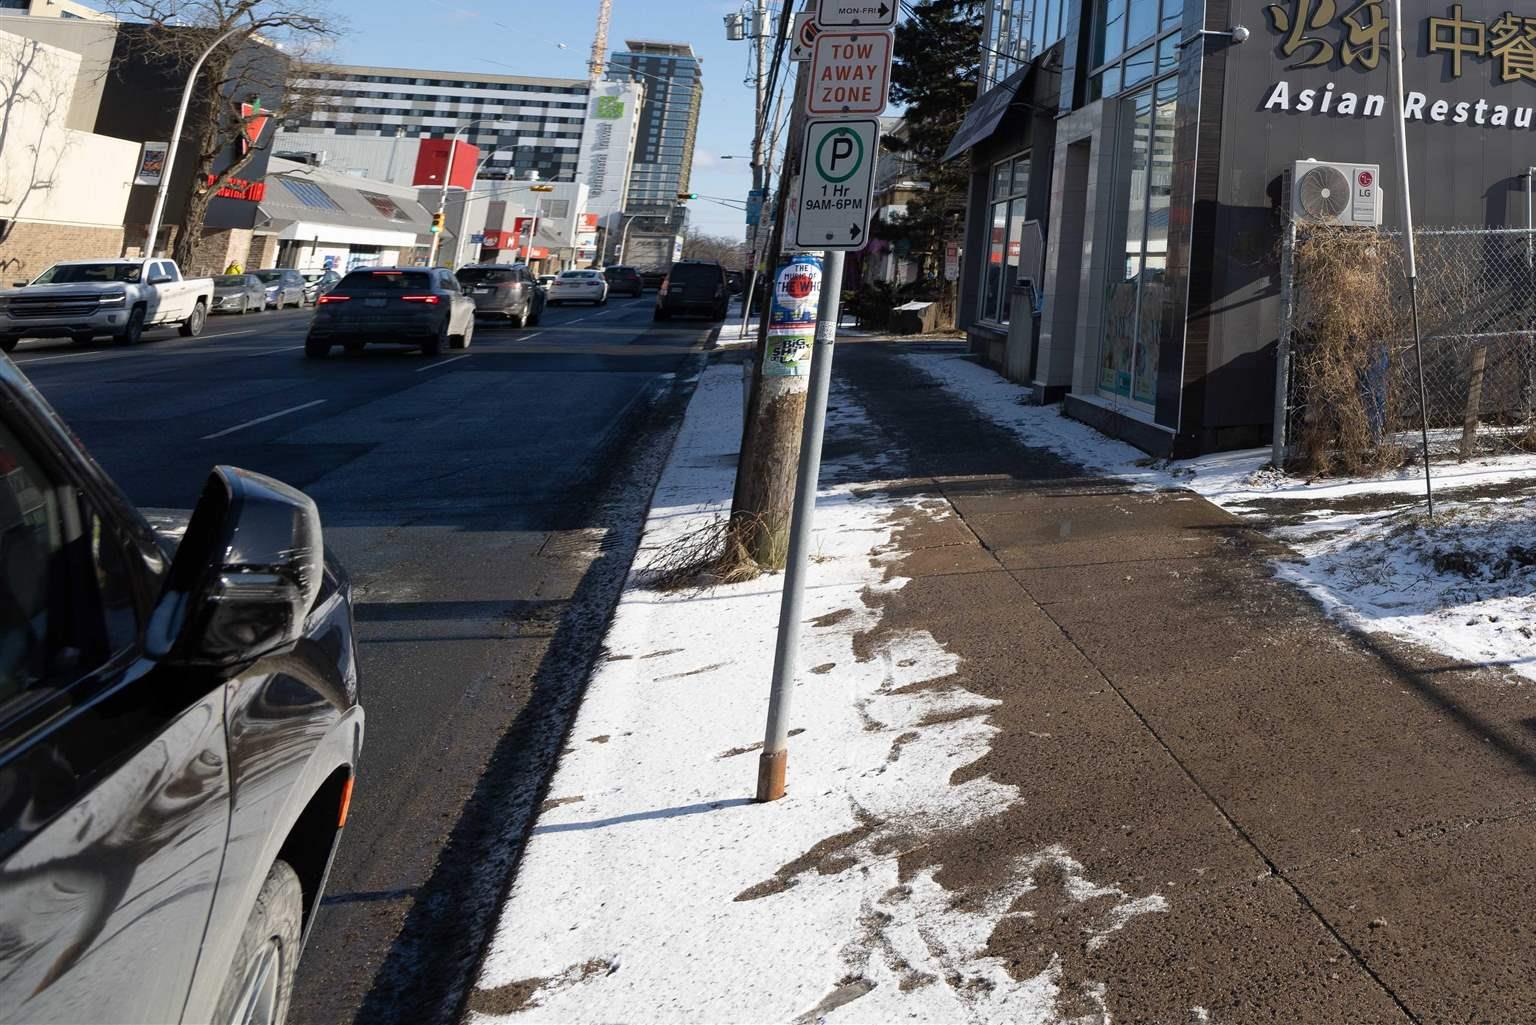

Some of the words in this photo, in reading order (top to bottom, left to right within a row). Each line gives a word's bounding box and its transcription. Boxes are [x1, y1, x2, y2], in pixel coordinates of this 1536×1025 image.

[832, 44, 873, 59] TOW
[821, 65, 878, 82] AWAY
[822, 87, 872, 103] ZONE
[1265, 81, 1384, 117] Asian
[821, 184, 828, 196] 1
[833, 185, 850, 197] Hr
[1359, 189, 1371, 198] LG
[806, 199, 862, 210] 9AM-6PM
[795, 264, 809, 272] THE
